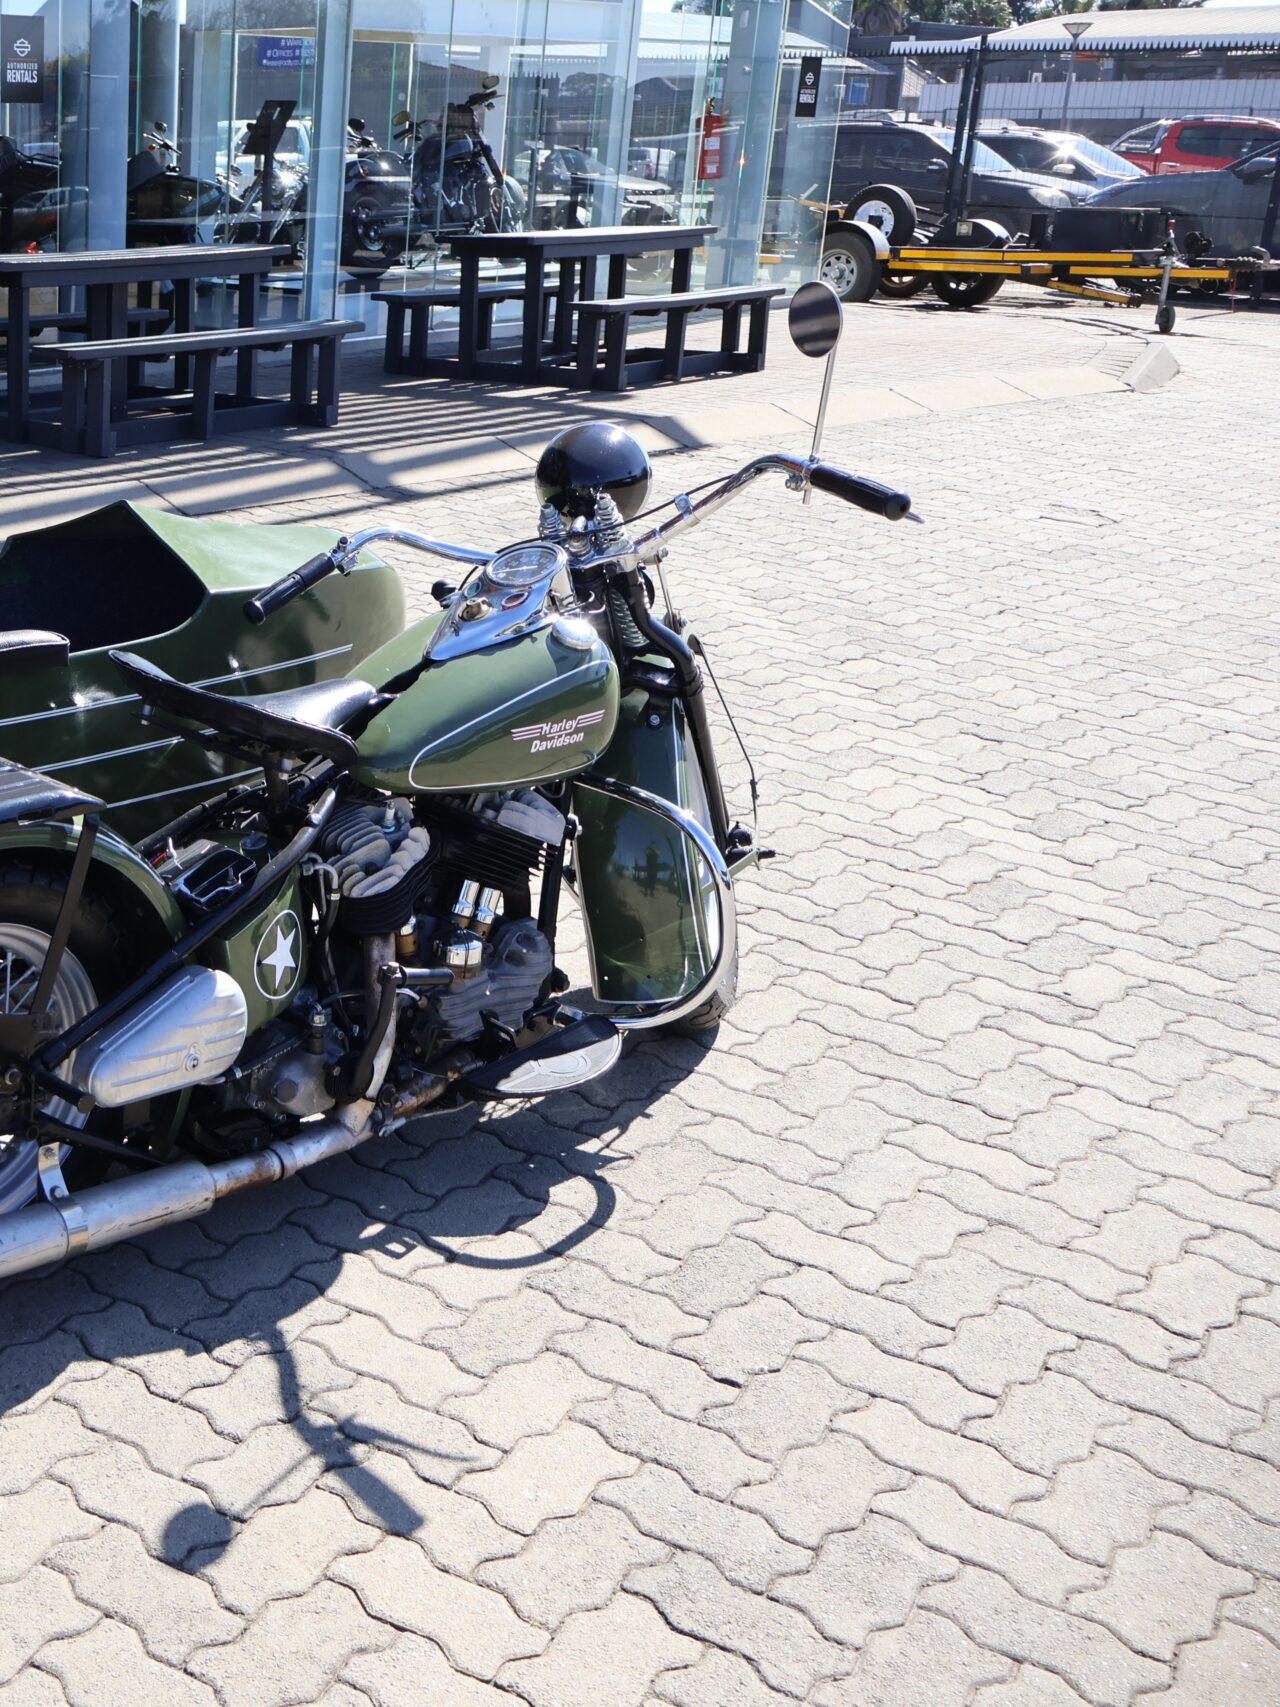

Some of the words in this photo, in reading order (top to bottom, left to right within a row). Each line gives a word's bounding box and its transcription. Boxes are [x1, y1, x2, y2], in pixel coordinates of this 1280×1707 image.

[7, 70, 38, 83] RENTALS
[541, 719, 579, 735] Harley
[530, 732, 584, 753] Davidson
